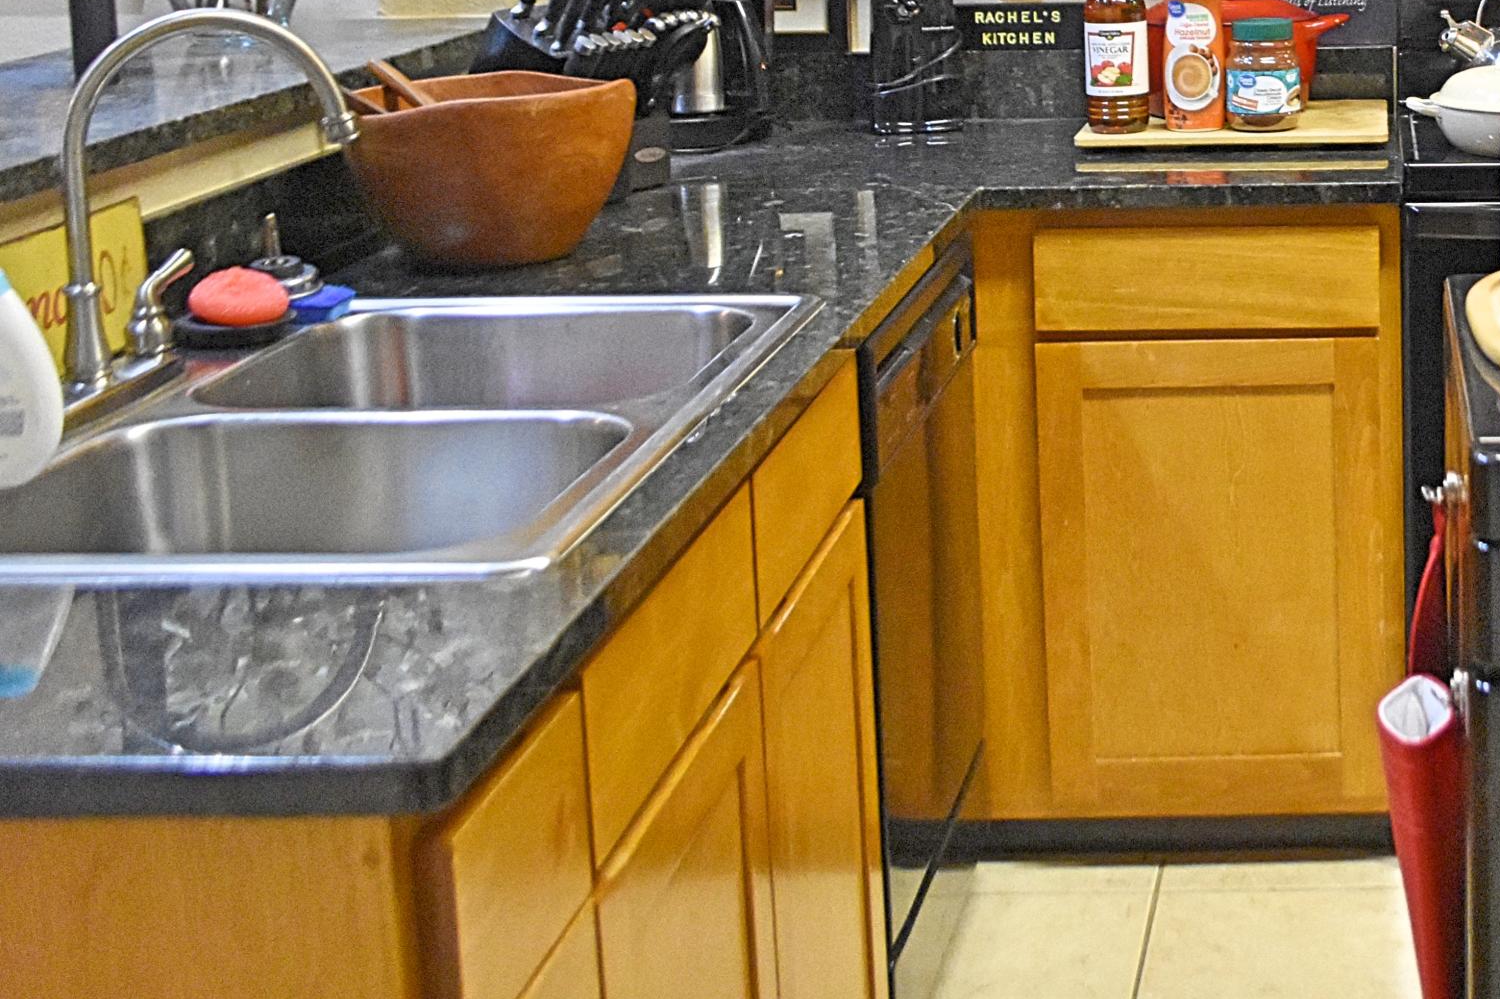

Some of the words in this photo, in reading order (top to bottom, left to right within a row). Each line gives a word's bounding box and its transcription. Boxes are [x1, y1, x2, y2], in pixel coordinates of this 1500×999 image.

[974, 11, 1061, 24] RACHEL'S
[982, 32, 1055, 45] KITCHEN
[1091, 46, 1129, 54] VINEGAR
